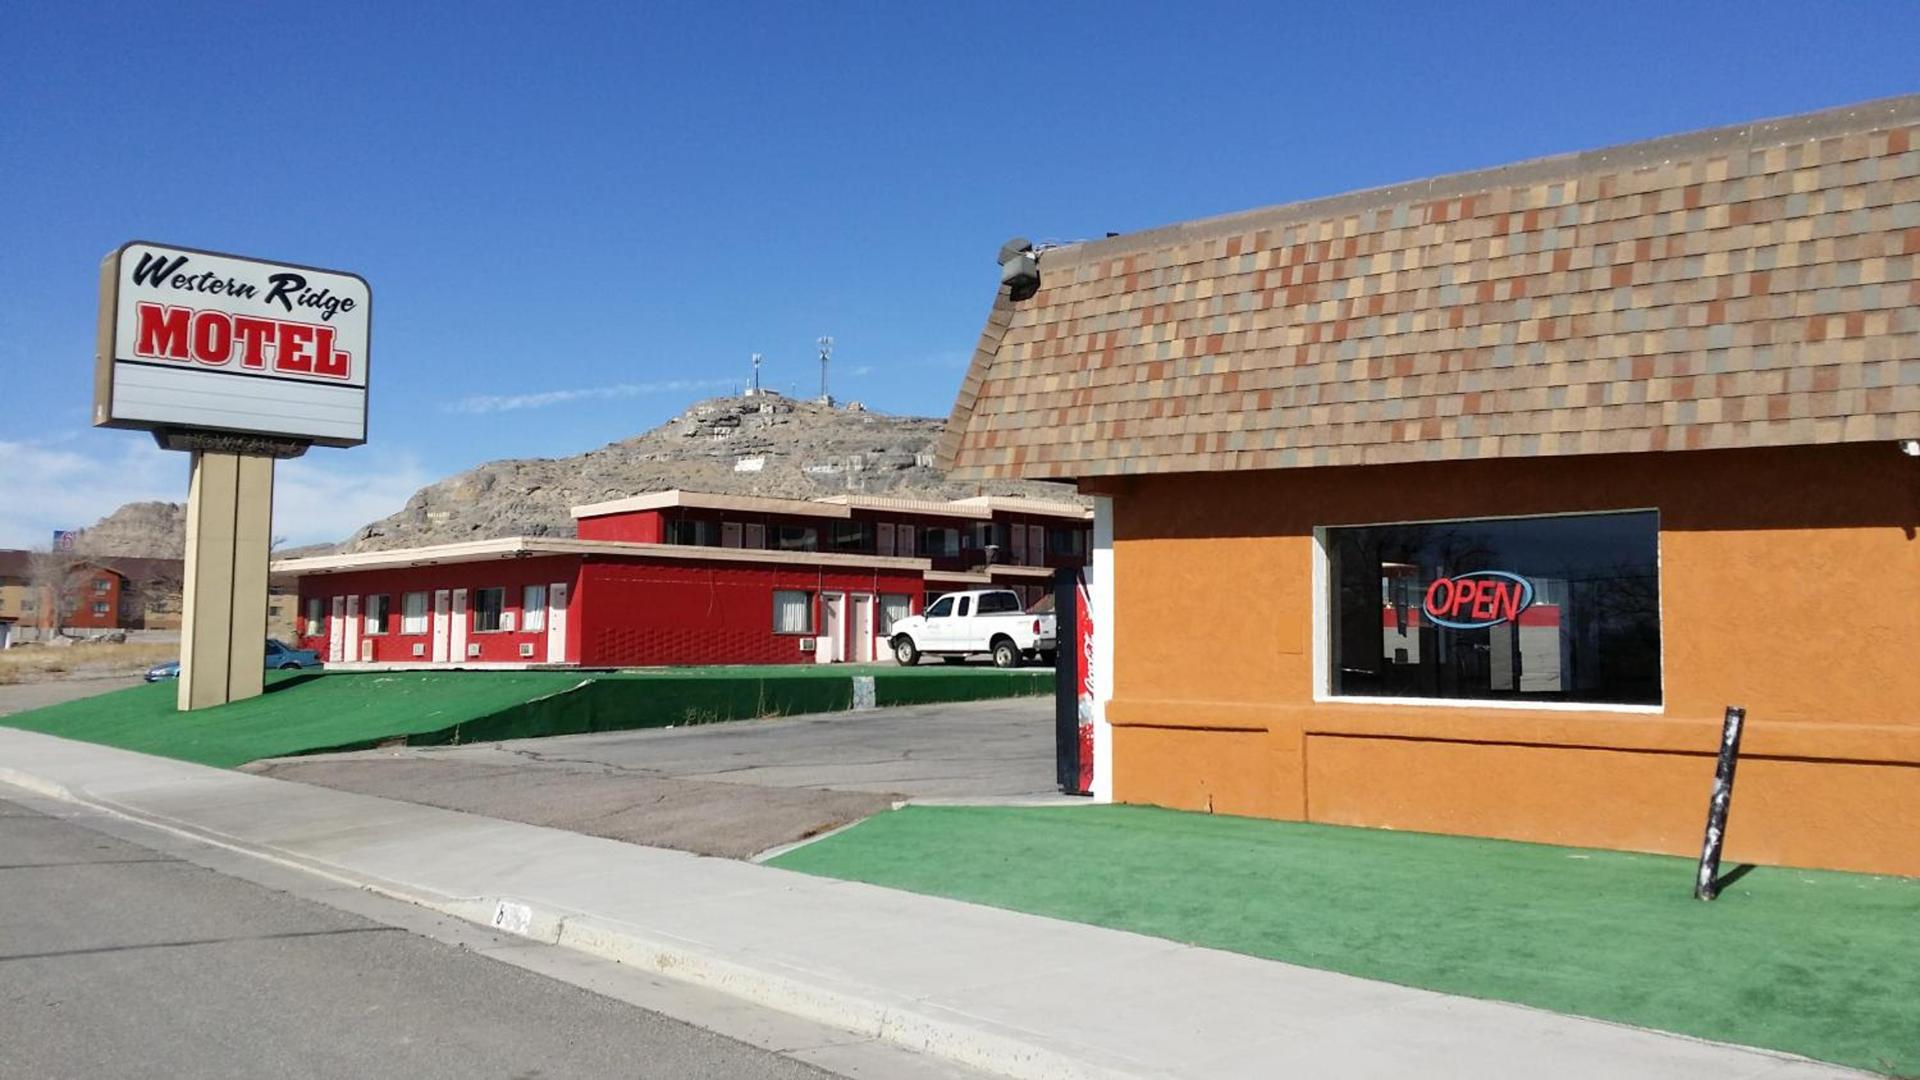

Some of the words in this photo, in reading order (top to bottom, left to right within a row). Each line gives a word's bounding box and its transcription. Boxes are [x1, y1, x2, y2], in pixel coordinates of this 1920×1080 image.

[132, 252, 260, 300] Western
[264, 273, 356, 321] Ridge
[134, 301, 351, 379] MOTEL
[1426, 577, 1522, 620] OPEN
